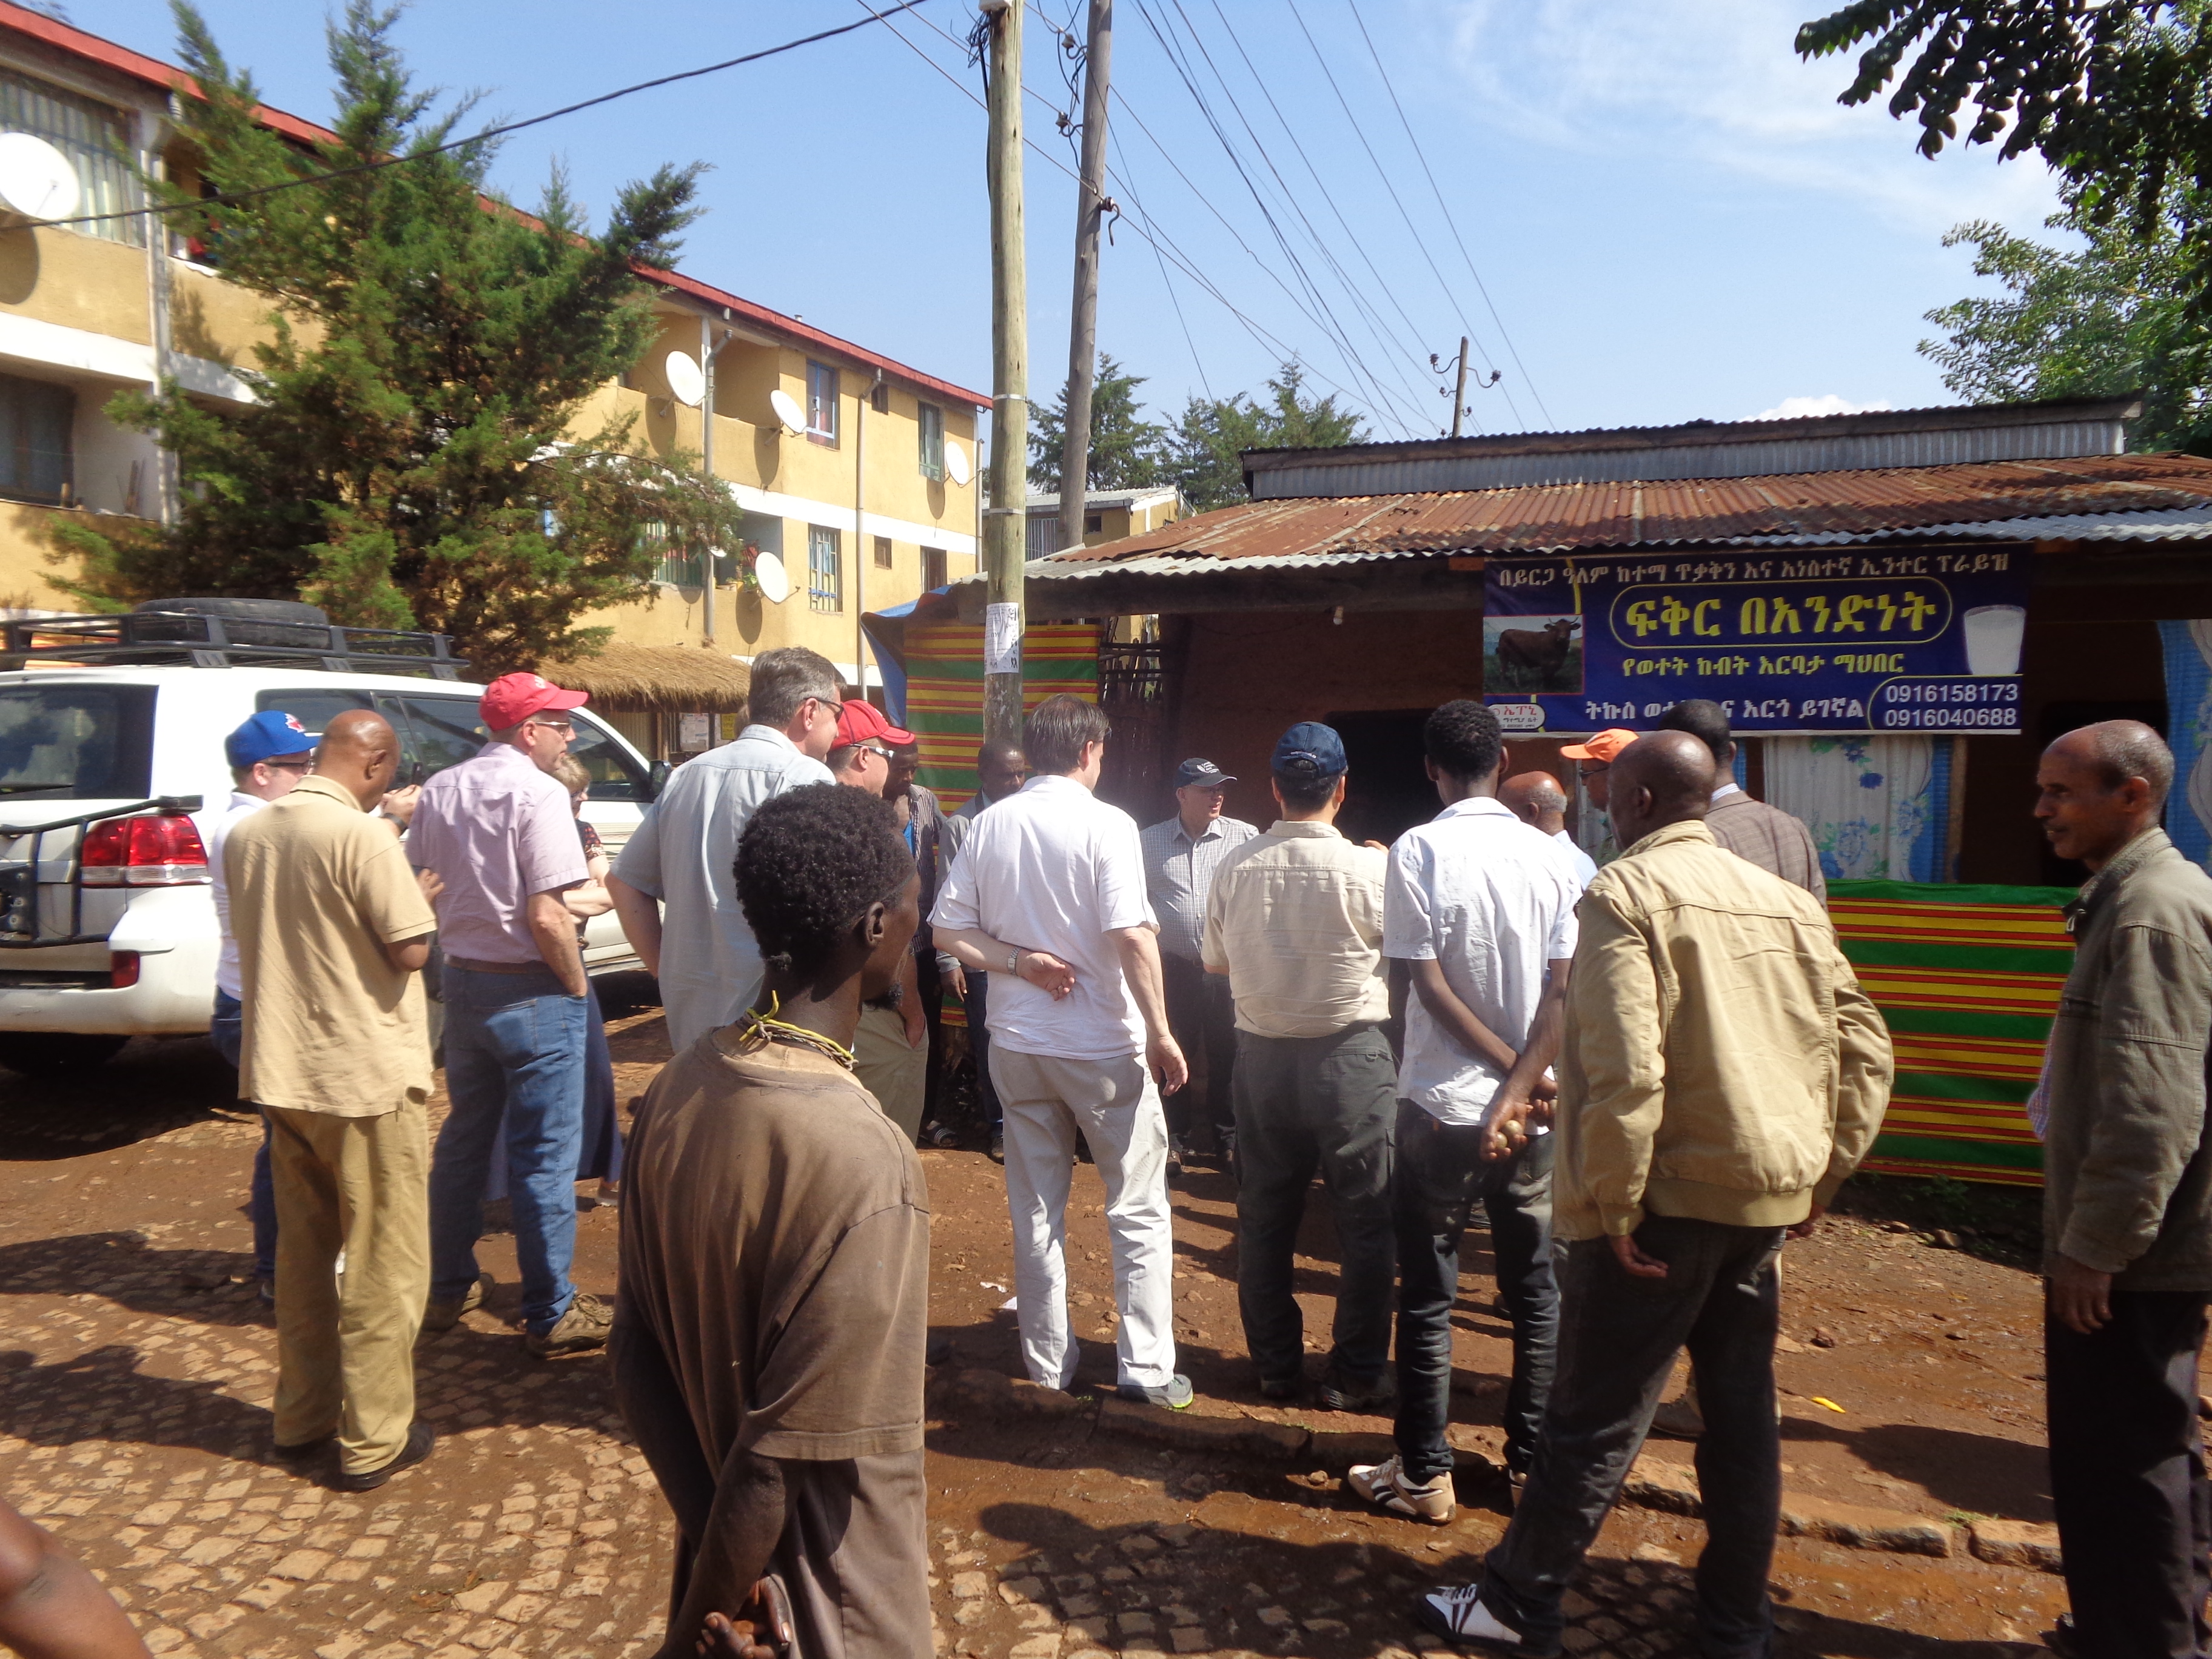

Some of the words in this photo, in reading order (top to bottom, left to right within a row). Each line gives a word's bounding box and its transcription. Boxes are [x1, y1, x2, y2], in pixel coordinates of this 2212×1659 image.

[1563, 566, 1608, 583] ዓለም
[1618, 564, 1667, 582] ከተማ
[1675, 561, 1735, 581] ጥቃቅን
[1744, 561, 1771, 577] እና
[1626, 595, 1721, 637] ፍቅር
[1740, 591, 1936, 634] በአንድነት
[1623, 657, 1689, 677] የወተት
[1697, 655, 1750, 675] ከብት
[1758, 655, 1826, 675] እርባታ
[1834, 652, 1905, 673] ማህበር
[1886, 683, 2018, 702] 0916158173
[1586, 701, 1636, 720] ትኩስ
[1799, 698, 1865, 720] ይገኛል
[1885, 708, 2016, 726] 0916040688
